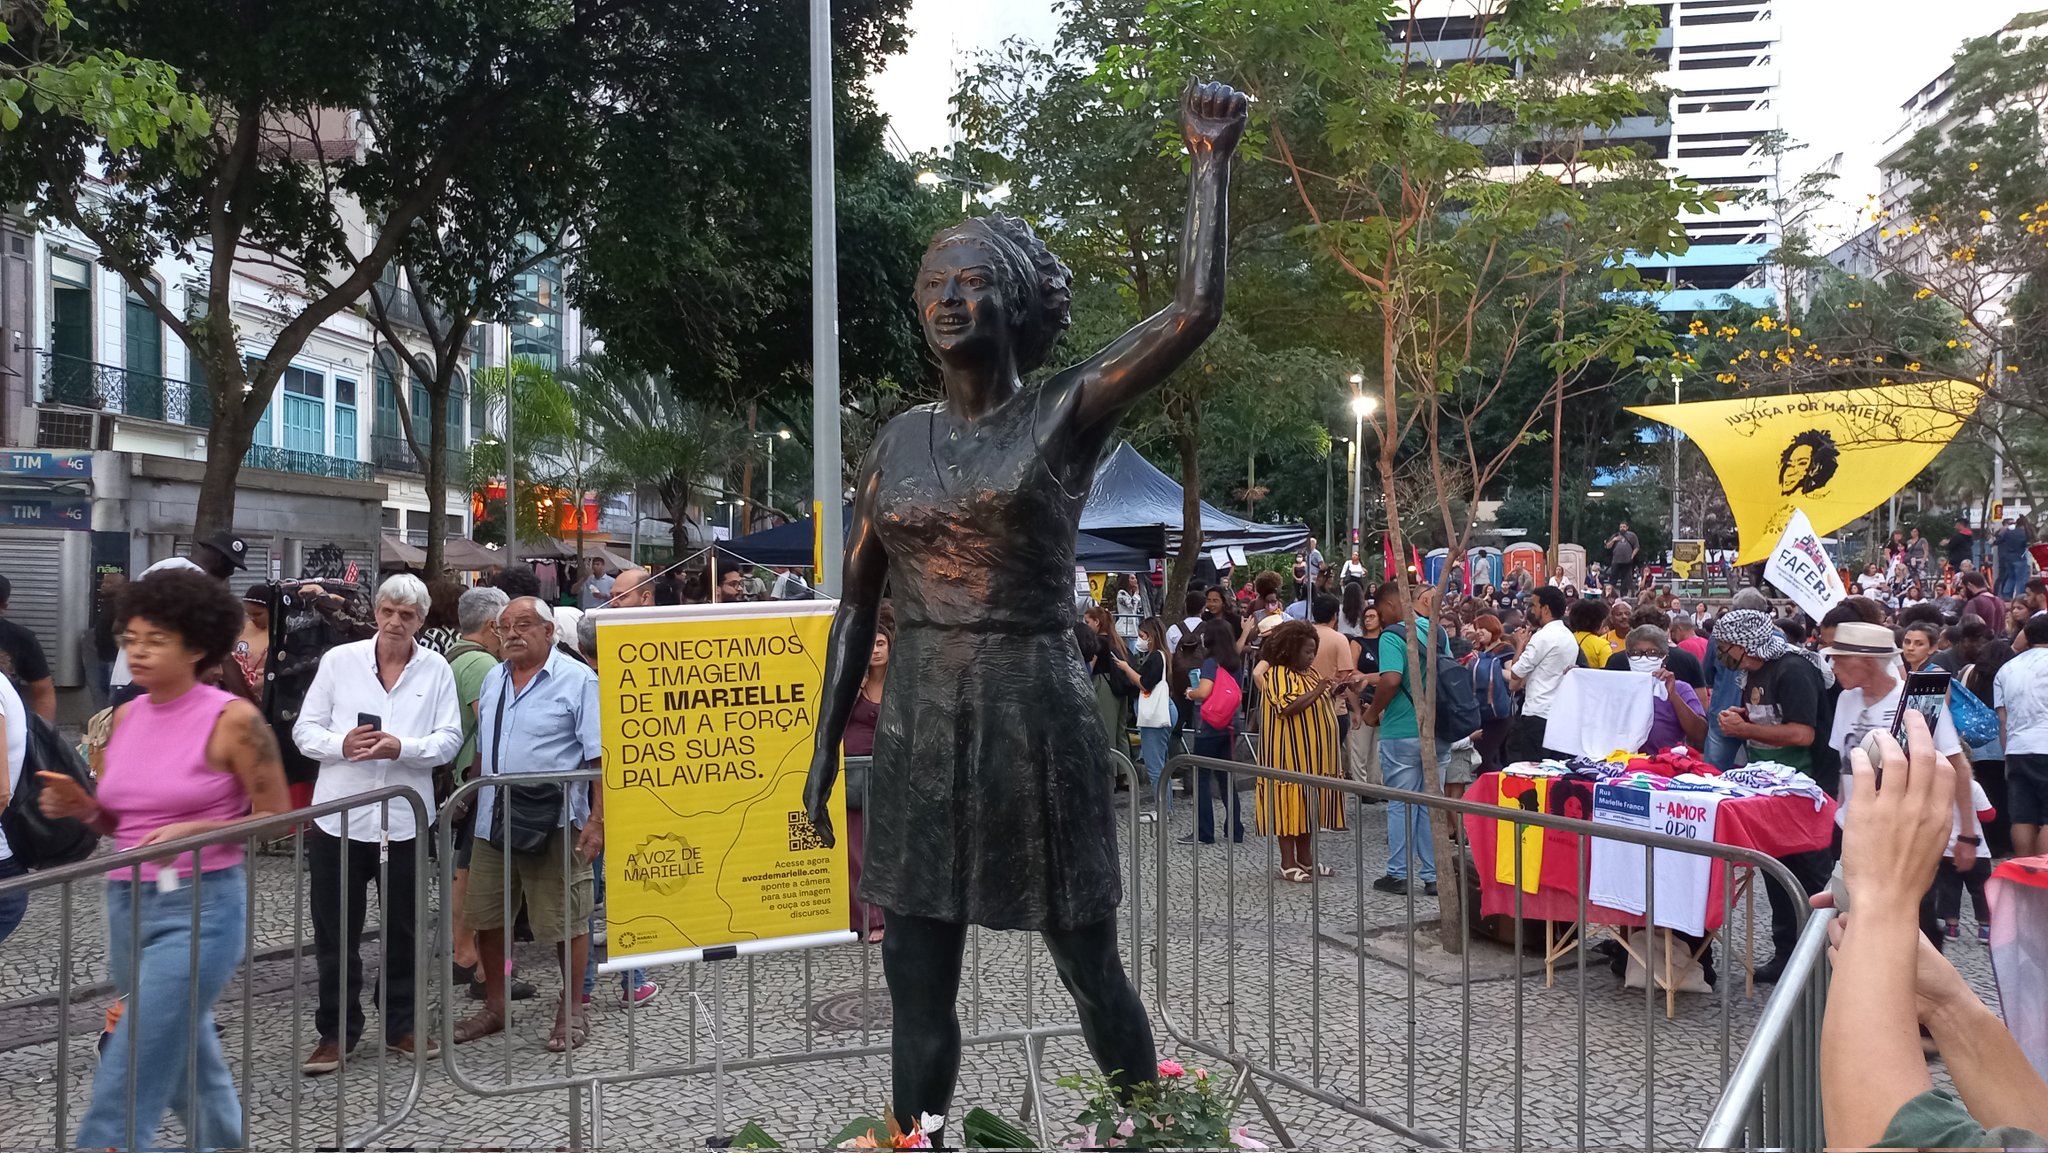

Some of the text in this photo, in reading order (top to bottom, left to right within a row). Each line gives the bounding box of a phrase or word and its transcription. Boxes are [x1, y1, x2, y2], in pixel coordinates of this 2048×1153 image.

[1787, 402, 1818, 414] POR
[13, 455, 84, 470] TIM 4G
[12, 505, 82, 520] TIM 4G
[618, 635, 804, 664] CONECTAMOS
[619, 662, 761, 689] A IMAGEM
[620, 683, 805, 714] DE MARIELLE
[621, 707, 810, 739] COM A FORÇA
[622, 735, 755, 765] DAS SUAS
[623, 760, 764, 788] PALAVRAS.
[1599, 788, 1611, 796] Rua
[1624, 801, 1645, 811] Franco
[1667, 801, 1707, 822] AMOR
[1665, 816, 1697, 839] ÓDIO
[626, 847, 701, 866] A VOZ DE
[775, 857, 830, 869] Acesse agora
[624, 861, 704, 882] MARIELLE
[761, 881, 790, 892] aponte
[800, 877, 831, 887] câmera
[761, 887, 831, 903] para sua imagem
[777, 901, 798, 911] ouça
[812, 897, 831, 906] seus
[790, 908, 831, 919] discursos.
